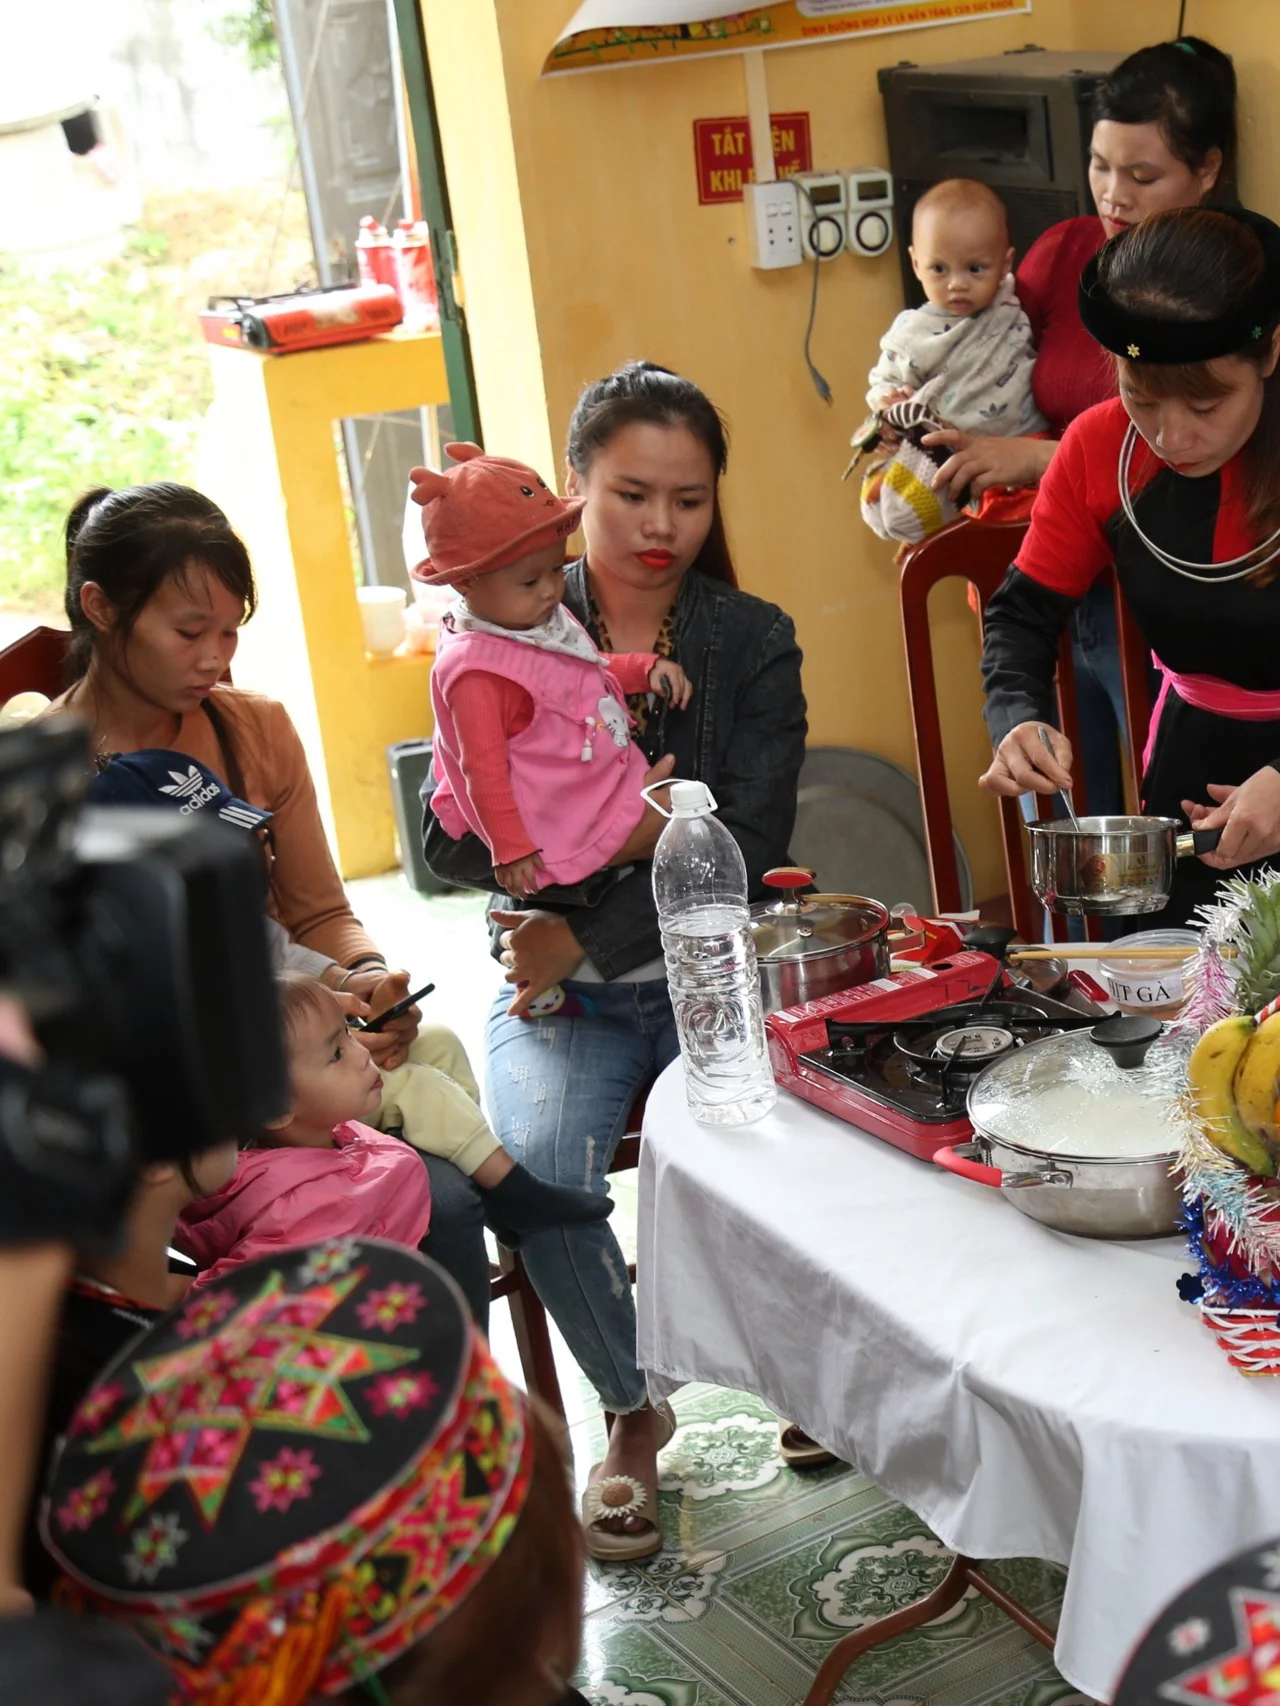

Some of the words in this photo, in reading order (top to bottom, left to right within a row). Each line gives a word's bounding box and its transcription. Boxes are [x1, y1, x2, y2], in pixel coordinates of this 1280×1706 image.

[773, 126, 795, 157] ỆN
[710, 168, 743, 192] KHI
[180, 783, 220, 815] adidas
[1137, 981, 1171, 1003] GÀ
